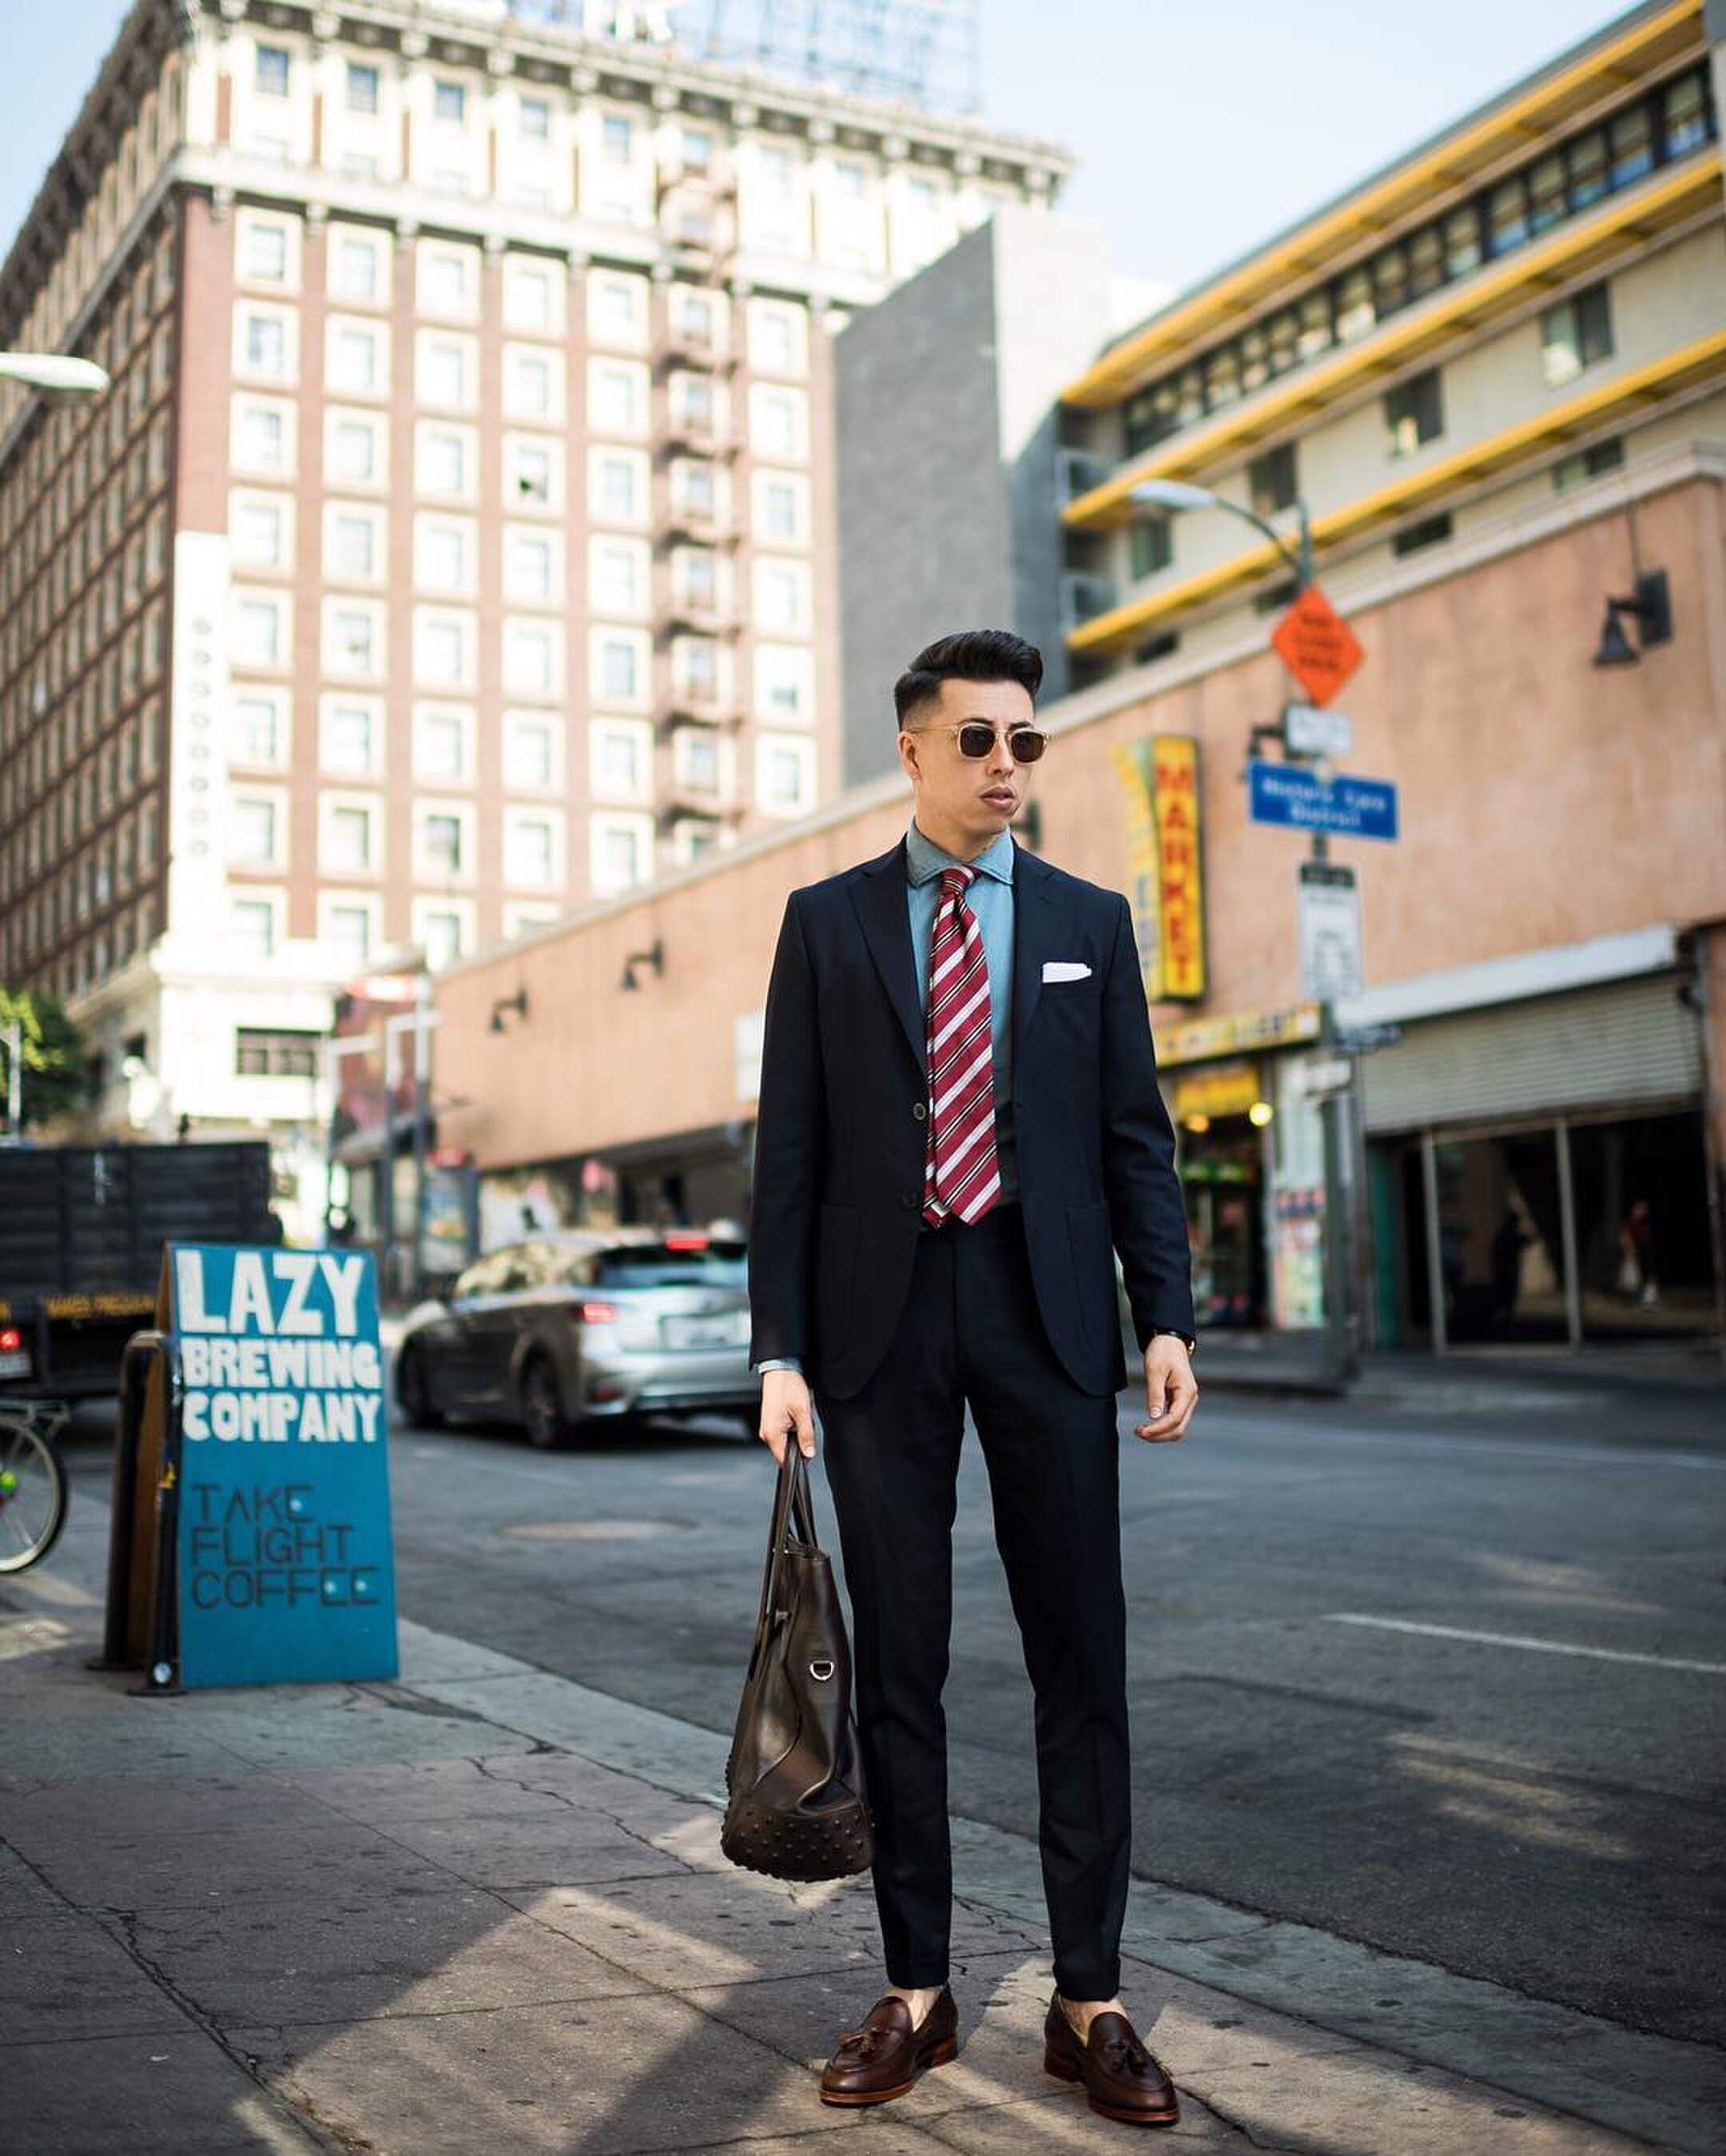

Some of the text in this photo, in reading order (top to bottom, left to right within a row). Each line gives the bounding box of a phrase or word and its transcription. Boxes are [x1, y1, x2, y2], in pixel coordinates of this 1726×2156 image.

[1155, 763, 1193, 981] MARKET
[175, 1250, 364, 1336] LAZY
[180, 1337, 381, 1390] BREWING
[182, 1392, 381, 1442] COMPANY
[193, 1483, 314, 1523] TAKE
[192, 1523, 356, 1566] FLIGHT
[193, 1566, 379, 1609] COFFEE
